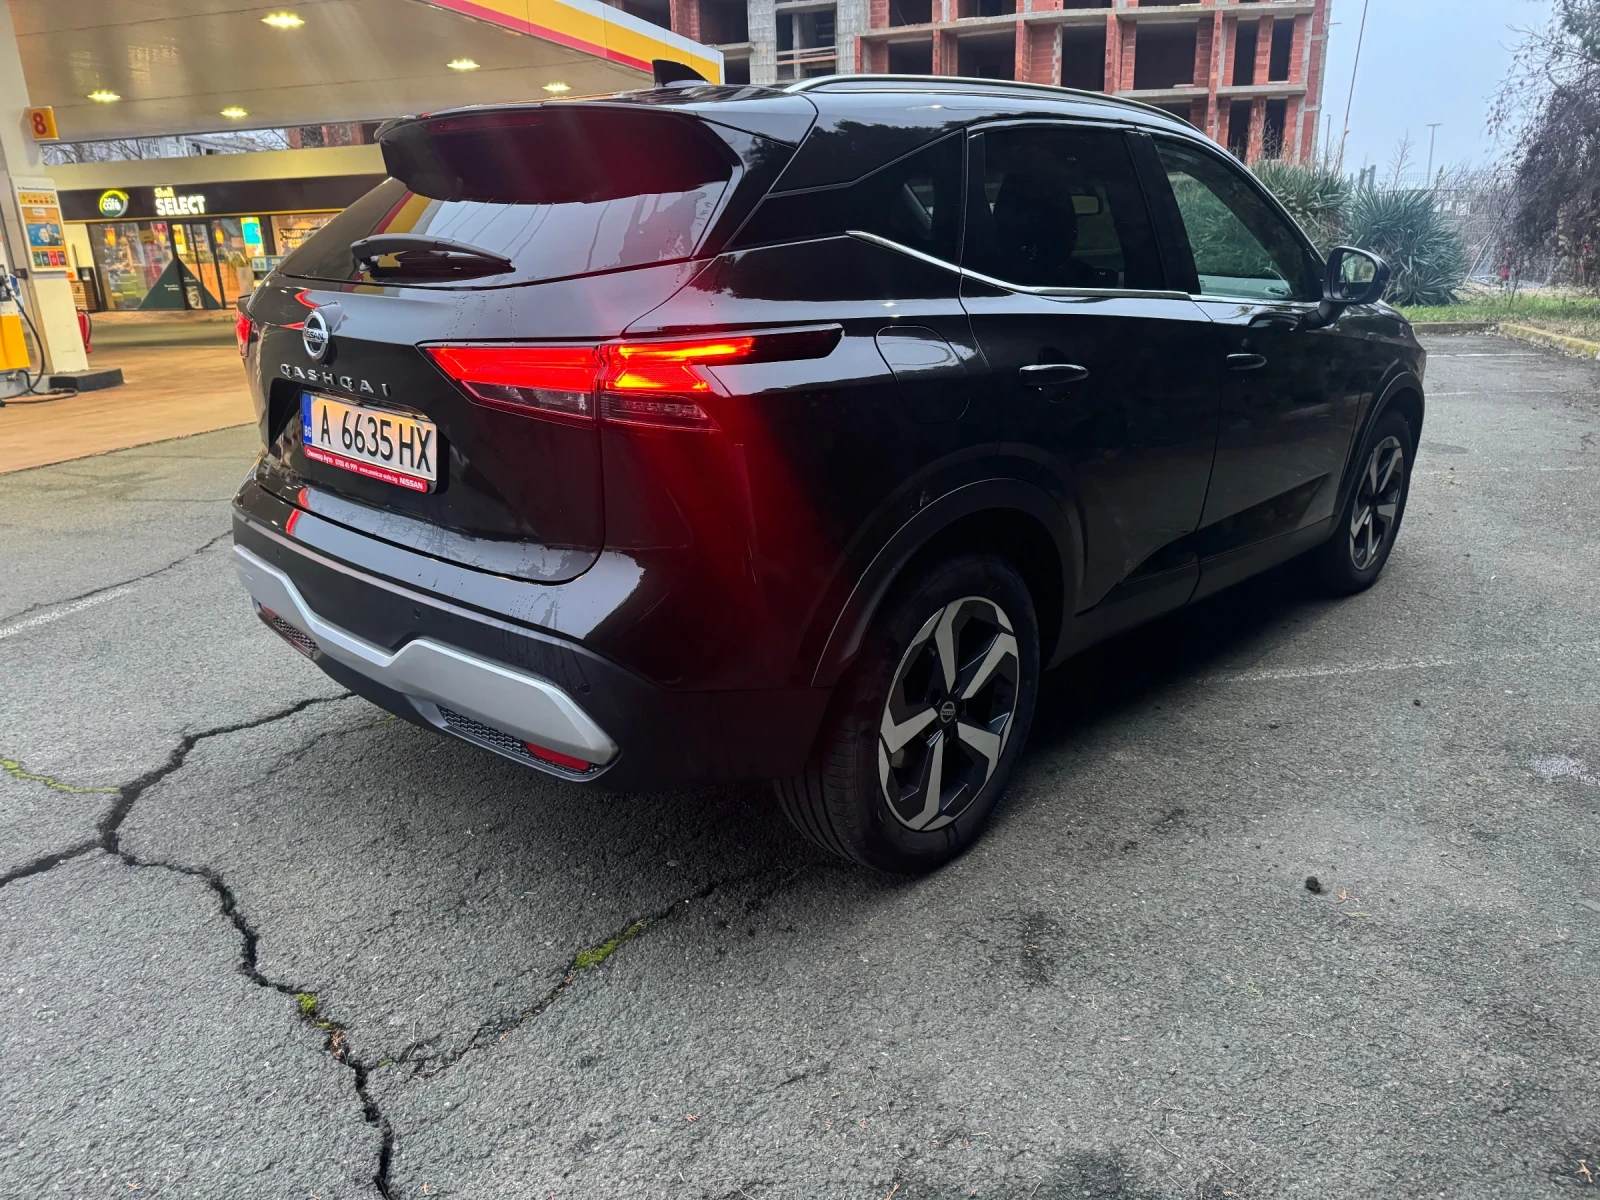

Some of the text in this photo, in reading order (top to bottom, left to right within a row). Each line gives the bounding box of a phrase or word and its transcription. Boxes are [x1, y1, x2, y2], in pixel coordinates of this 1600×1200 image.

[32, 112, 47, 135] 8
[154, 187, 174, 198] Shell
[155, 195, 205, 216] SELECT
[280, 363, 390, 397] QASHQAI
[304, 425, 312, 438] BG
[321, 405, 431, 473] A 6635 HX
[399, 476, 424, 490] NISSAN
